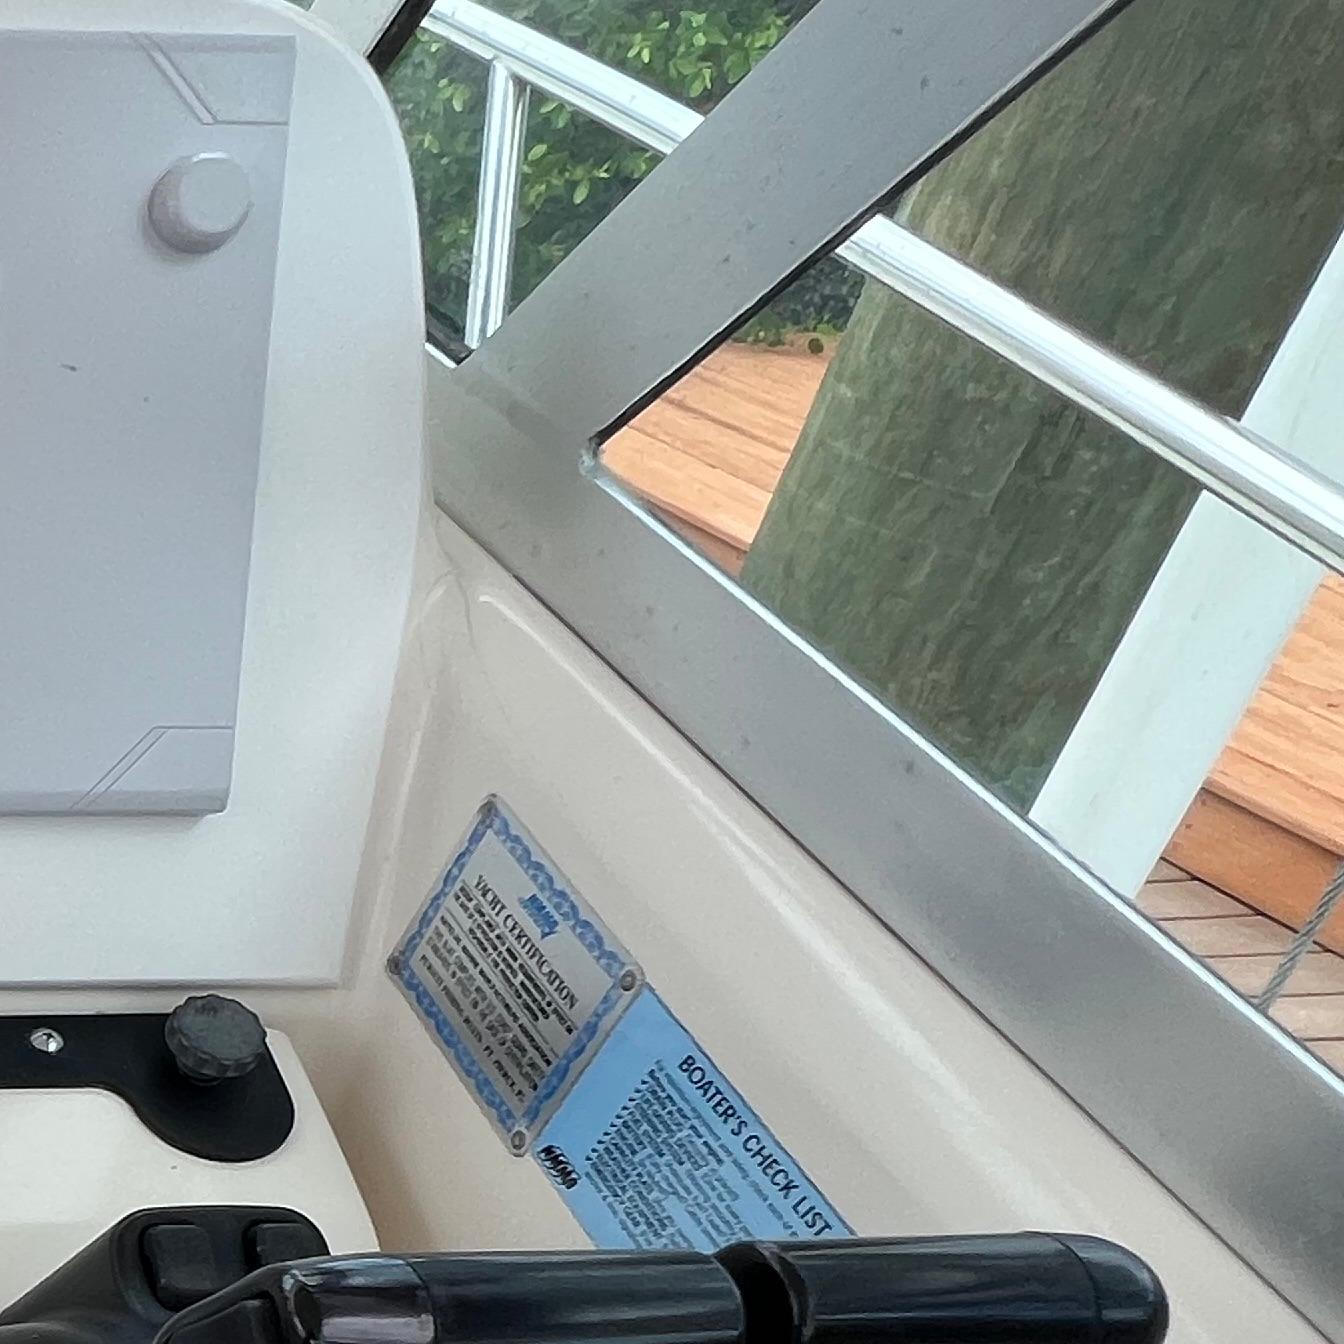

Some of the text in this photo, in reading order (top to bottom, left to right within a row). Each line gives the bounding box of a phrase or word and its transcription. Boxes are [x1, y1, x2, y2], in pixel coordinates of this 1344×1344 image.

[503, 914, 579, 1010] CERTIFICATION
[677, 1055, 748, 1136] BOATER'S
[742, 1134, 799, 1200] CHECK
[791, 1196, 833, 1237] LIST
